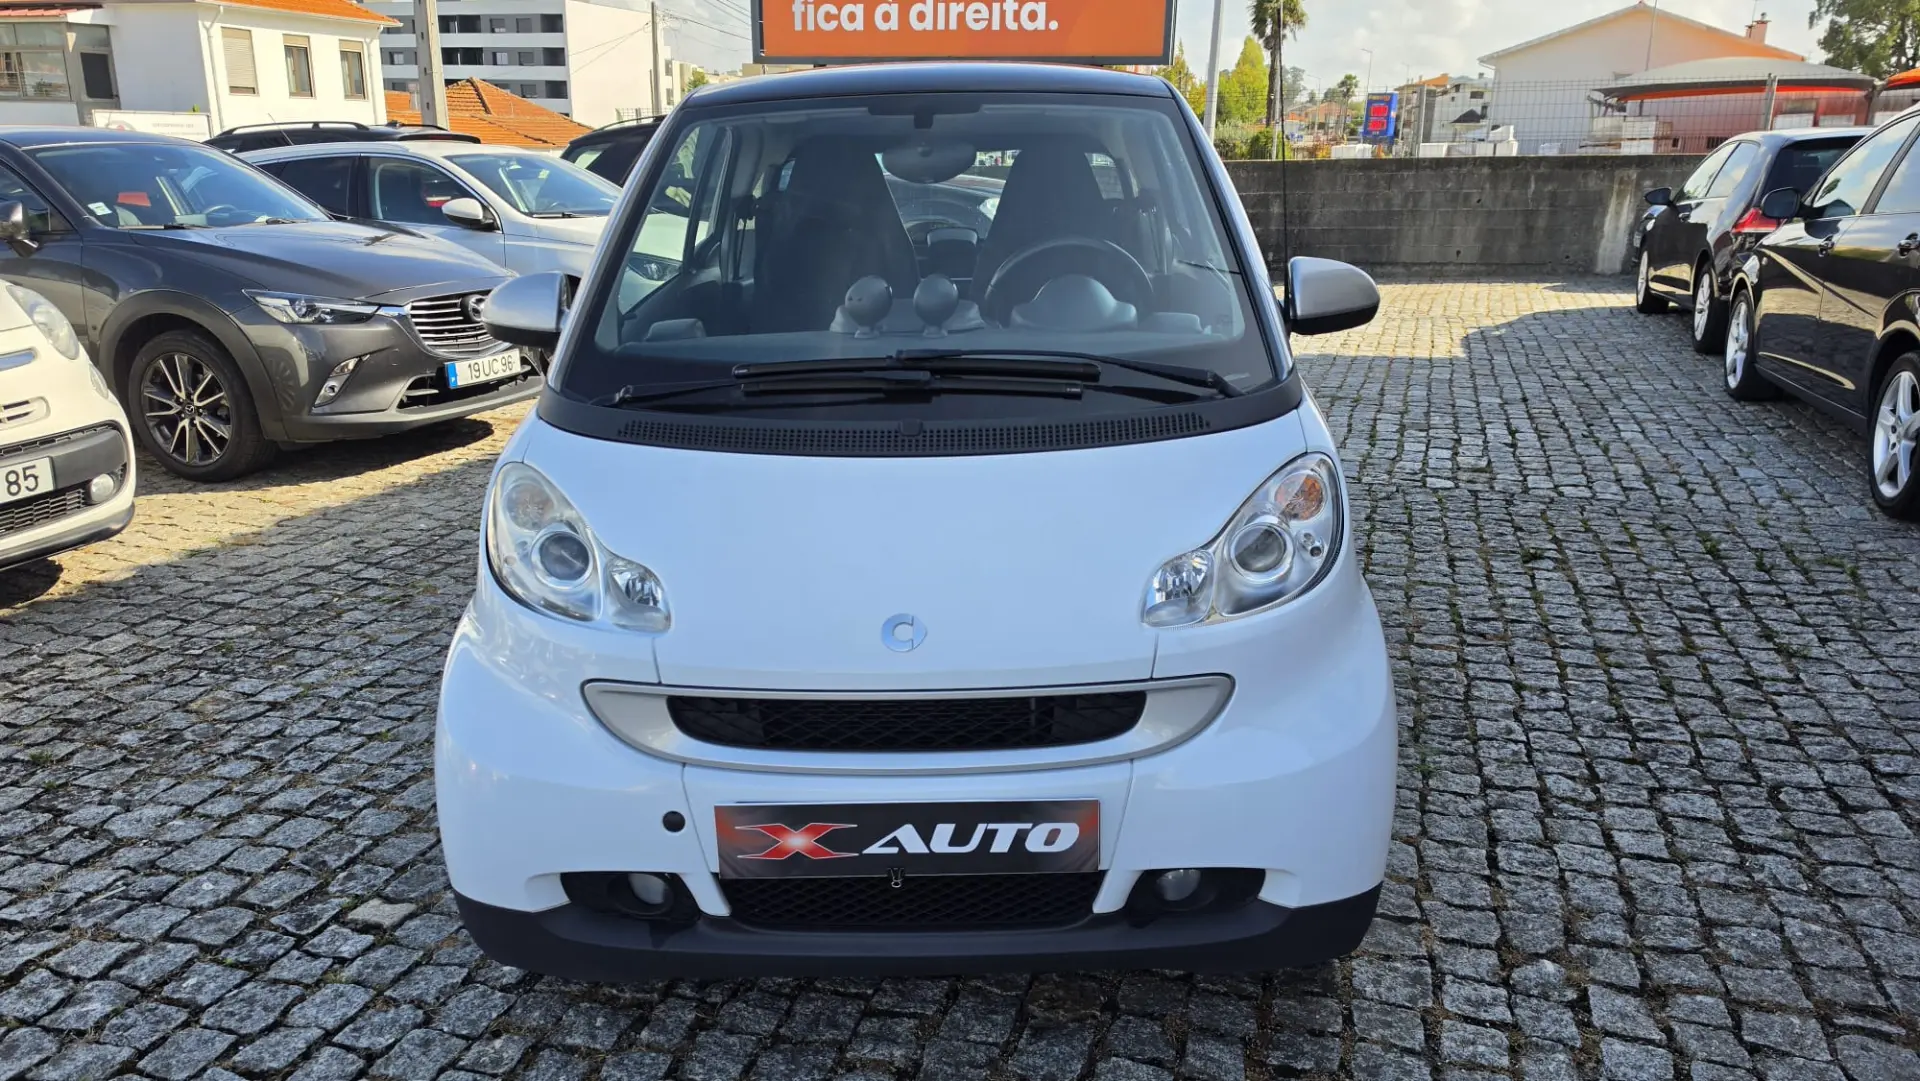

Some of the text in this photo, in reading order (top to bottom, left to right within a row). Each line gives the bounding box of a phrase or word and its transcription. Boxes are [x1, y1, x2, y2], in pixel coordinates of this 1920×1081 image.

[792, 0, 864, 31] fica
[908, 0, 1059, 31] direita.
[5, 465, 38, 496] 85
[862, 822, 1080, 854] AUTO
